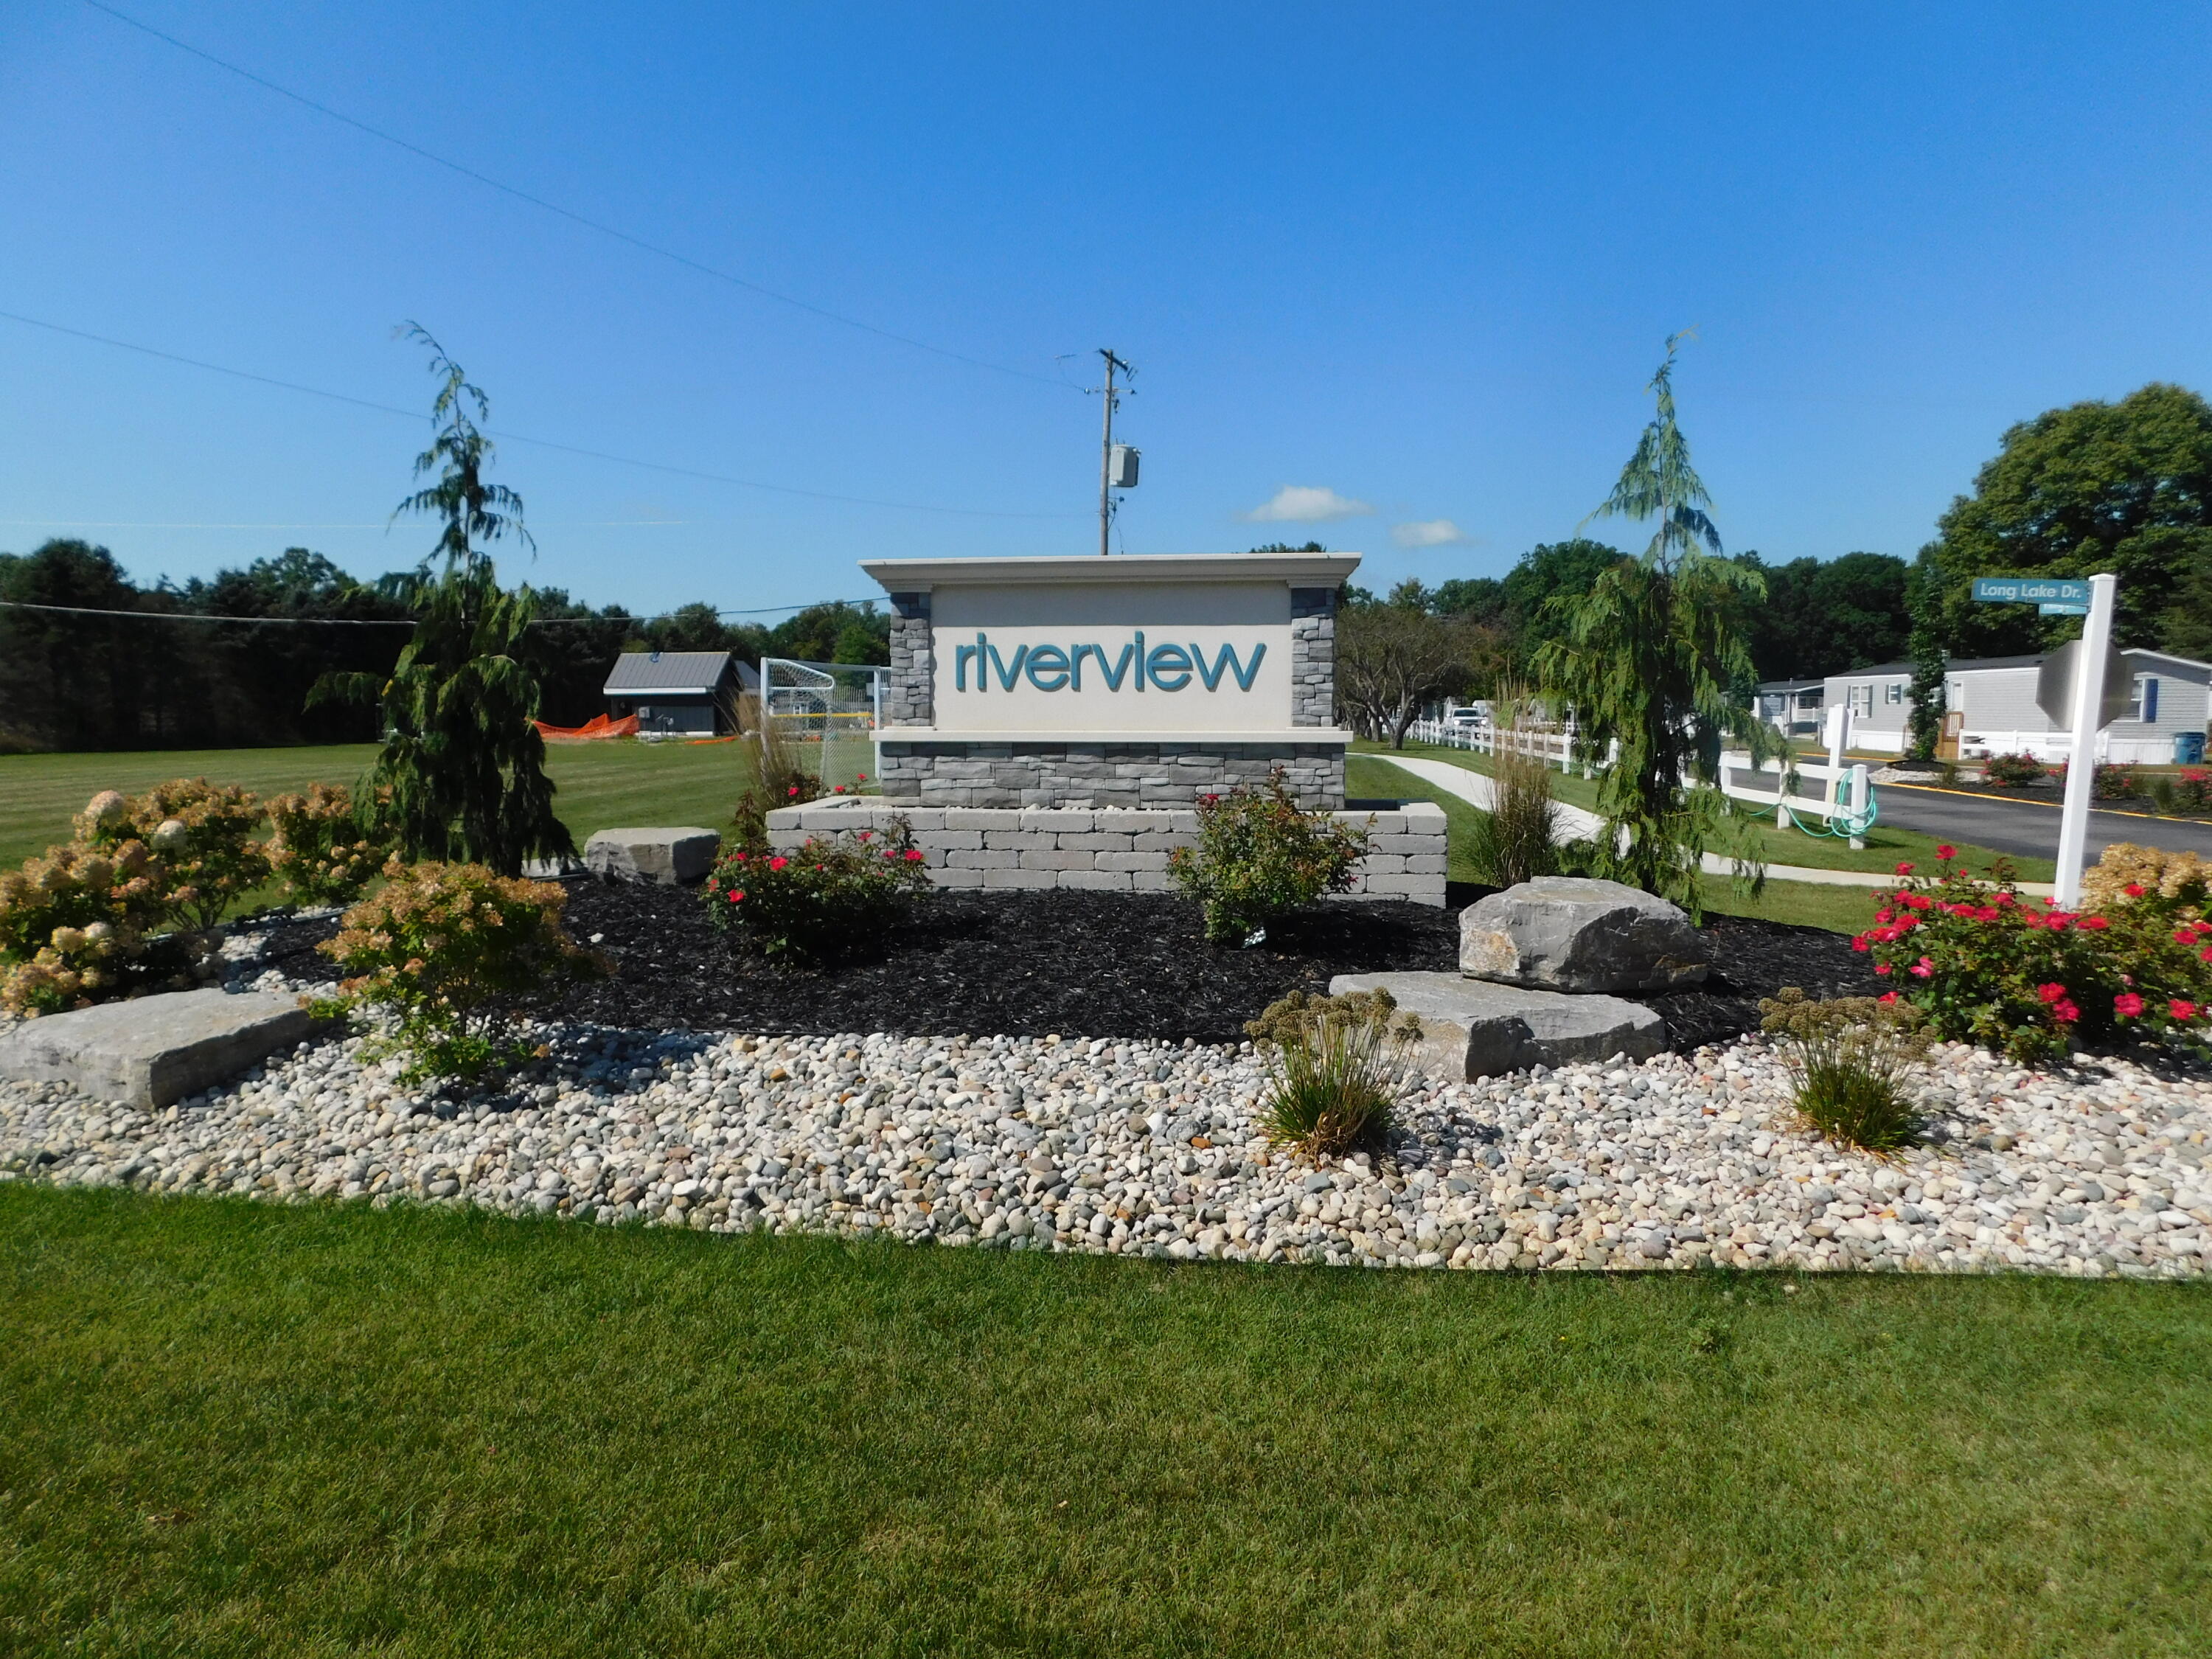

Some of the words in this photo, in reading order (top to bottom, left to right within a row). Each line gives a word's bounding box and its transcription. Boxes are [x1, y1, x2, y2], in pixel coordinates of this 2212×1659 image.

[1980, 582, 2017, 600] Long
[2021, 584, 2056, 597] Lake
[2061, 585, 2081, 598] Dr.
[956, 630, 1267, 692] riverview
